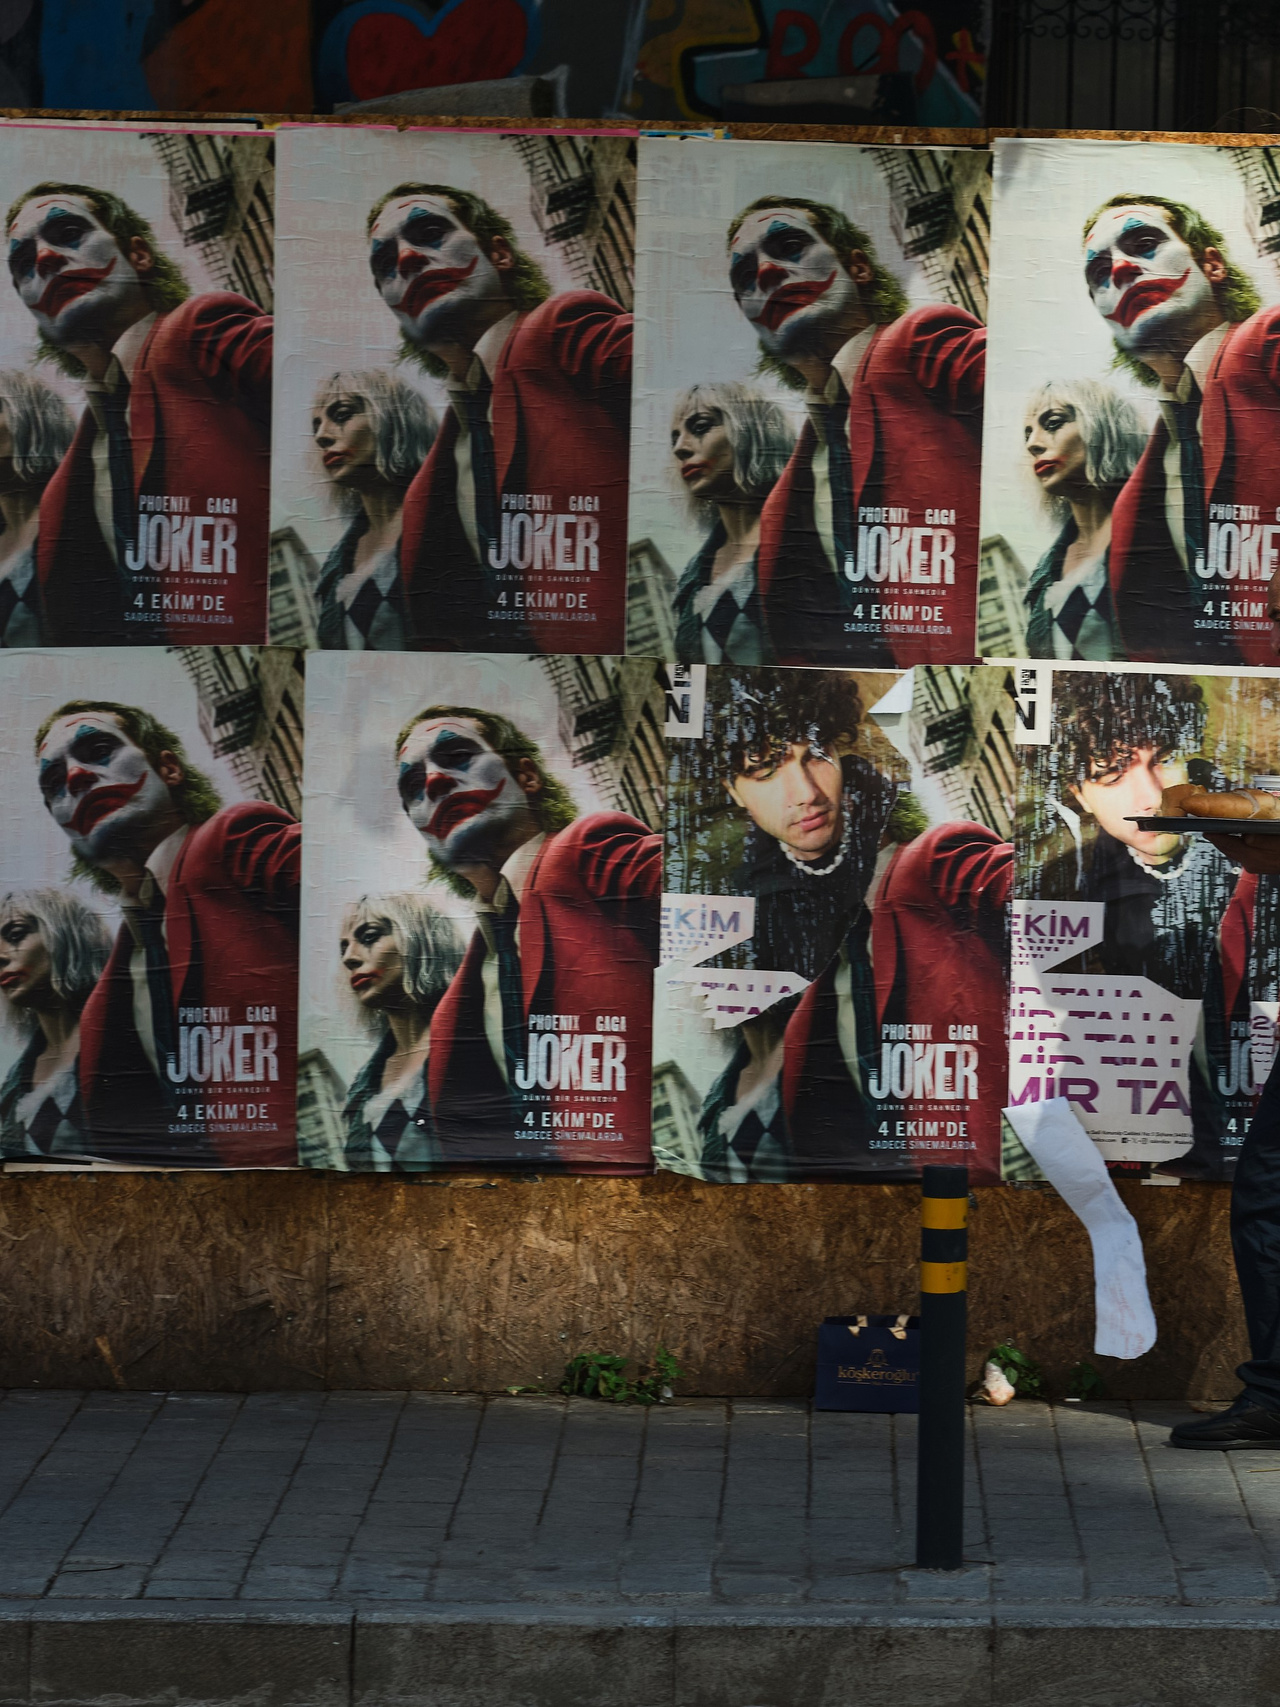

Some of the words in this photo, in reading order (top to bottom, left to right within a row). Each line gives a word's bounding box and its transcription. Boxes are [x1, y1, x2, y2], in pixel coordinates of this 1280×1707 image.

[139, 495, 190, 512] PHOENIX
[207, 498, 237, 514] GAGA
[501, 494, 553, 510] PHOENIX
[569, 496, 599, 511] GAGA
[859, 507, 909, 523] PHOENIX
[925, 509, 955, 525] GAGA
[1210, 504, 1260, 521] PHOENIX
[125, 514, 237, 573] JOKER
[488, 513, 599, 571] JOKER
[845, 525, 955, 584] JOKER
[133, 593, 144, 608] 4
[151, 592, 225, 610] EKİM'DE
[497, 592, 507, 606] 4
[515, 590, 588, 608] EKİM'DE
[1203, 601, 1214, 615] 4
[488, 610, 525, 620] SADECE
[853, 604, 864, 619] 4
[871, 602, 943, 621] EKİM'DE
[844, 623, 881, 632] SADECE
[179, 1007, 230, 1023] PHOENIX
[247, 1006, 277, 1022] GAGA
[529, 1014, 580, 1031] PHOENIX
[596, 1016, 626, 1031] GAGA
[882, 1024, 932, 1040] PHOENIX
[948, 1025, 978, 1040] GAGA
[167, 1026, 279, 1083] JOKER
[515, 1033, 626, 1091] JOKER
[869, 1043, 979, 1099] JOKER
[1117, 1079, 1192, 1116] TA
[177, 1104, 188, 1119] 4
[195, 1102, 268, 1119] EKİM'DE
[524, 1112, 534, 1126] 4
[542, 1110, 615, 1128] EKİM'DE
[878, 1121, 889, 1136] 4
[896, 1119, 968, 1136] EKİM'DE
[1227, 1118, 1238, 1132] 4
[514, 1130, 552, 1140] SADECE
